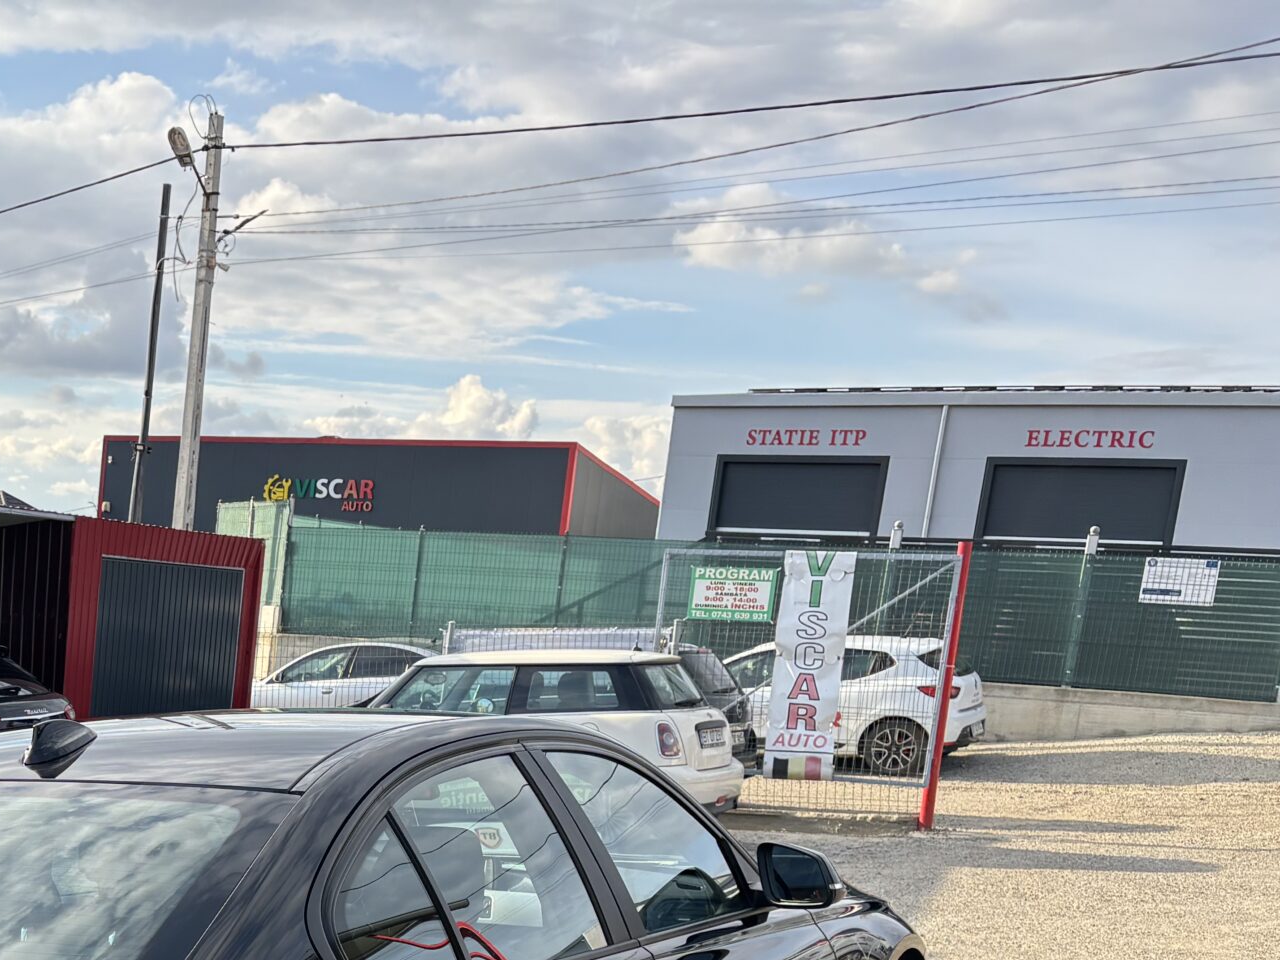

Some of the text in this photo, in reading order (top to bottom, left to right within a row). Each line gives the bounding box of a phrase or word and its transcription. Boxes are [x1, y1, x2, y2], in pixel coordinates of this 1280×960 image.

[746, 429, 867, 446] STATIE ITP
[1024, 429, 1155, 449] ELECTRIC
[295, 478, 374, 499] VISCAR
[341, 501, 373, 511] AUTO
[695, 568, 773, 580] PROGRAM
[773, 732, 828, 748] AUTO
